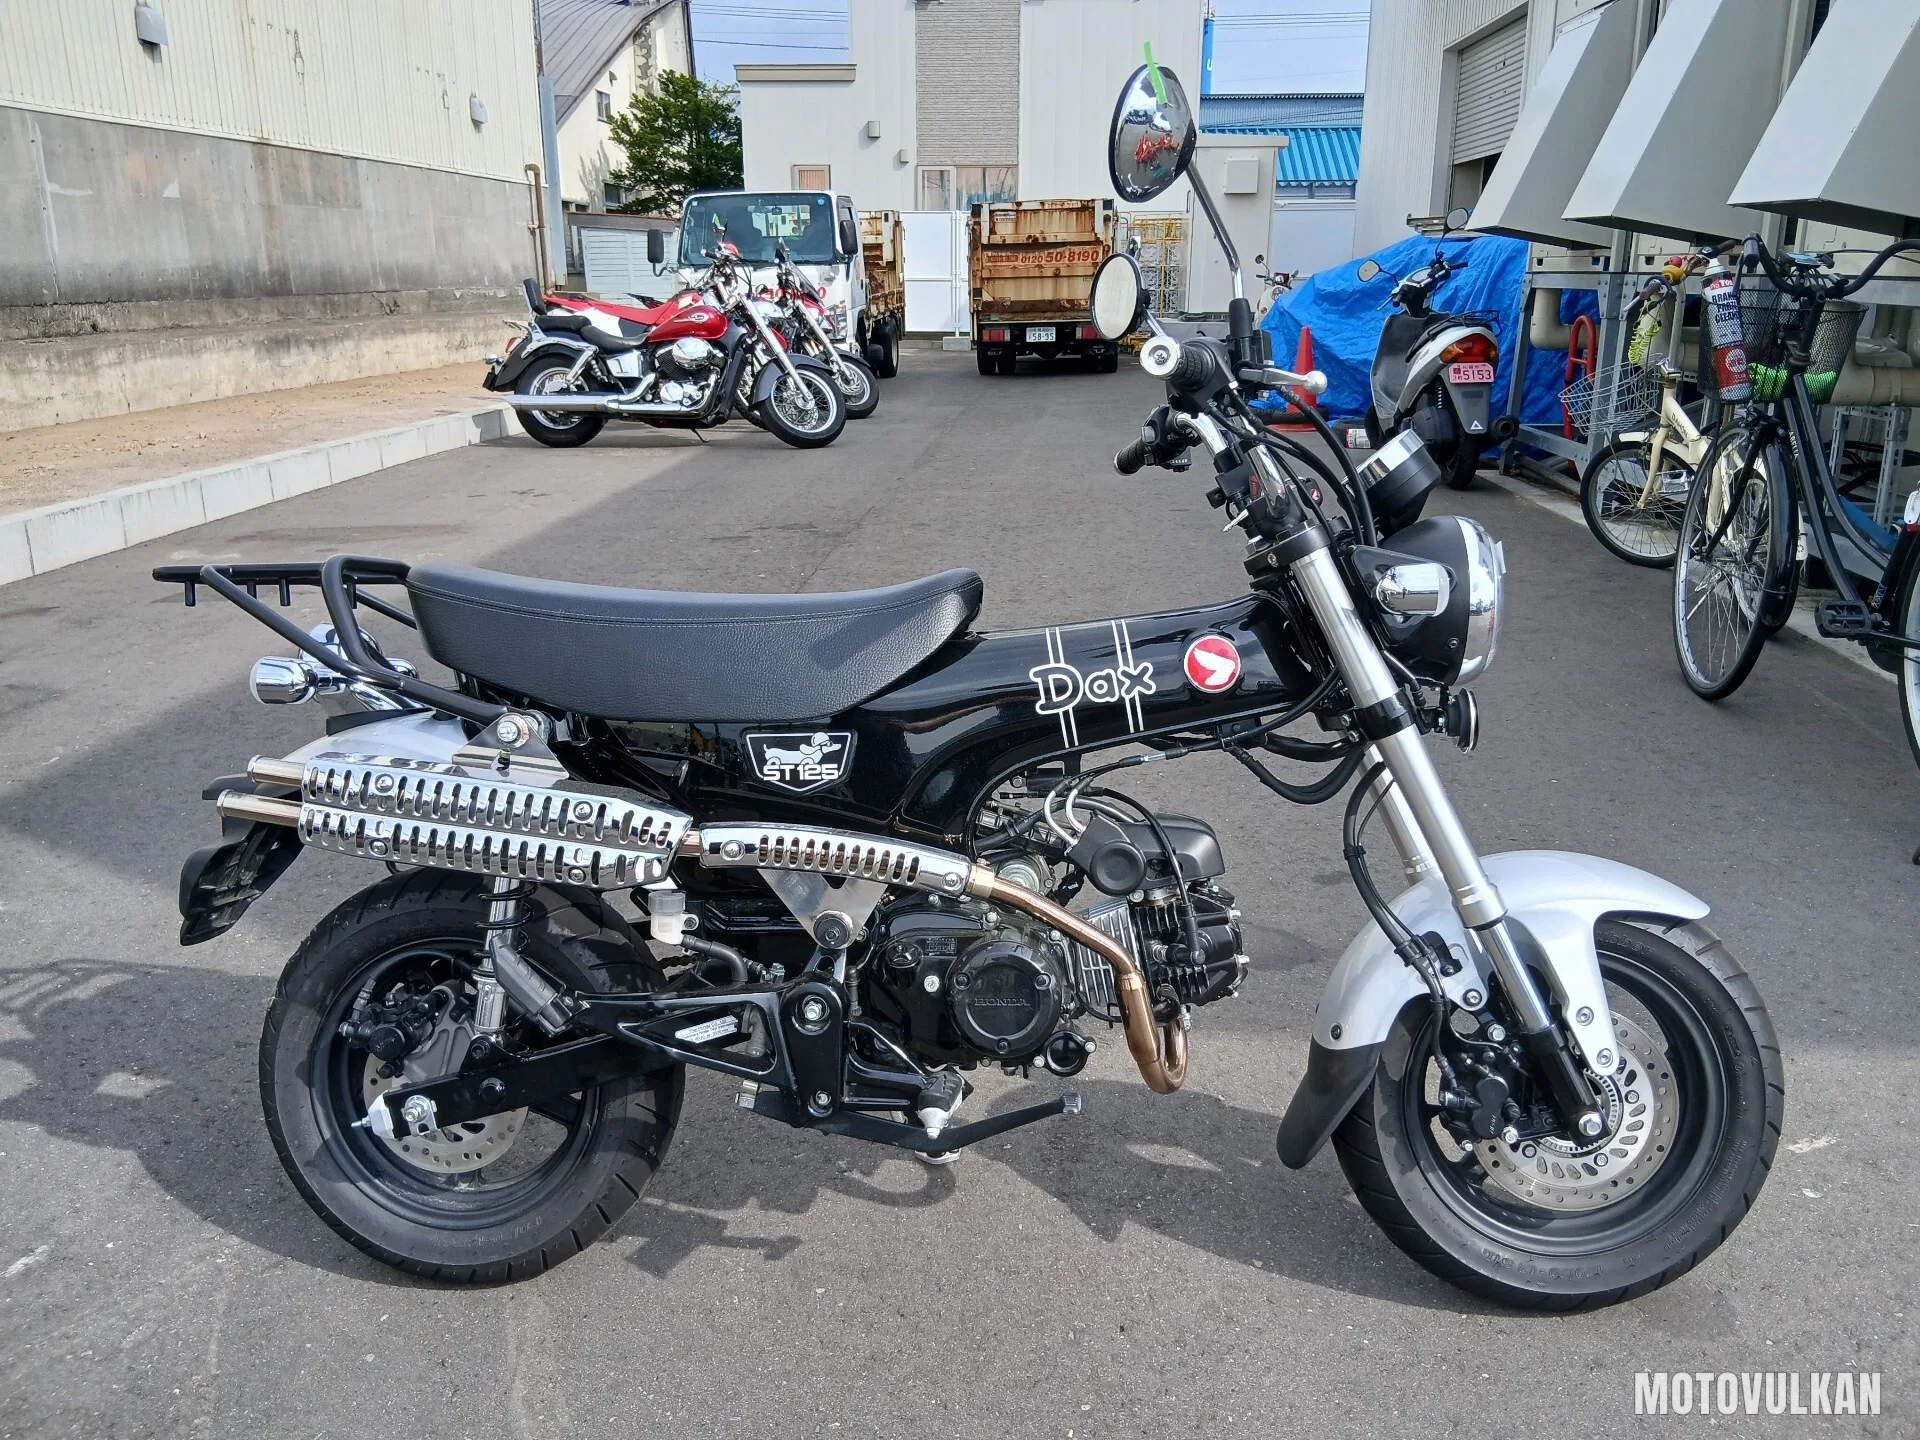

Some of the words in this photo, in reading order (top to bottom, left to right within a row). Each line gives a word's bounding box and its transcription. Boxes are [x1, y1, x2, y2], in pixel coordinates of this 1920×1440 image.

[1021, 255, 1043, 264] 0120
[1045, 250, 1100, 263] 50-8190
[1032, 332, 1054, 341] 58-95
[1462, 369, 1492, 380] 5153
[1029, 661, 1156, 715] Dax
[763, 764, 839, 781] ST125
[974, 996, 1031, 1006] HONDA
